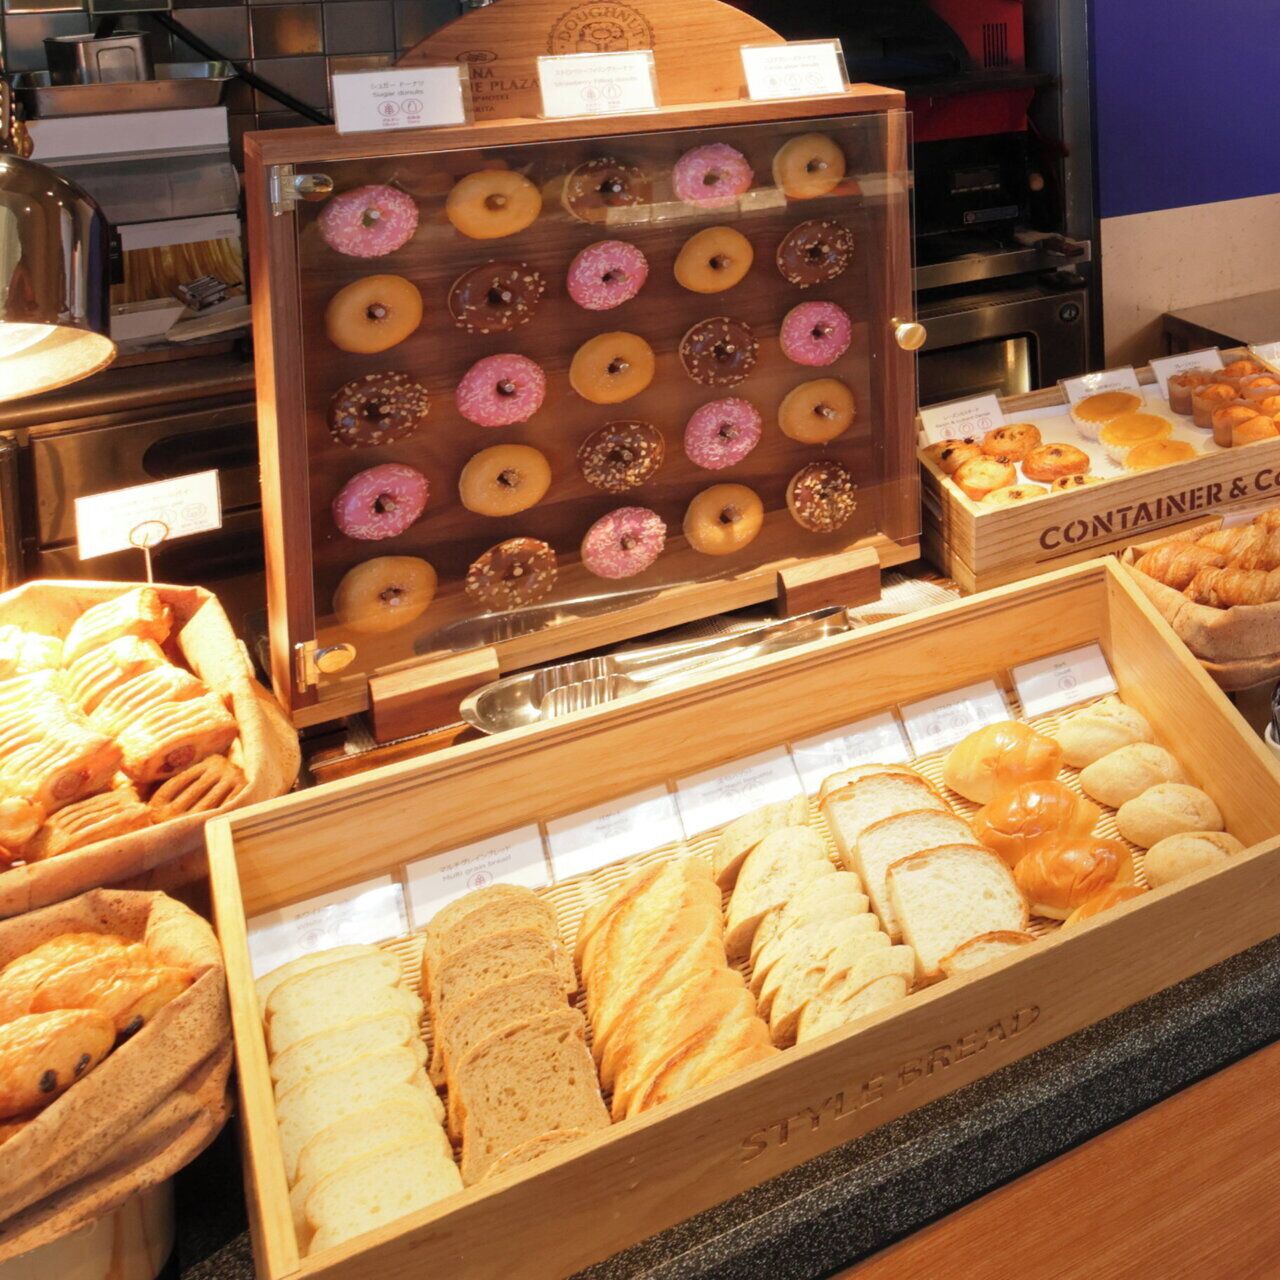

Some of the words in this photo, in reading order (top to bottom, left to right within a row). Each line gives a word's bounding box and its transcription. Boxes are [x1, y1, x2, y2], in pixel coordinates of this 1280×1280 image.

[560, 7, 645, 42] DOUGHNUT
[372, 90, 395, 99] Sugar
[490, 78, 539, 91] PLAZA
[1039, 483, 1223, 549] CONTAINER
[1229, 477, 1248, 499] &
[741, 1072, 884, 1164] STYLE
[896, 1004, 1041, 1092] BREAD
